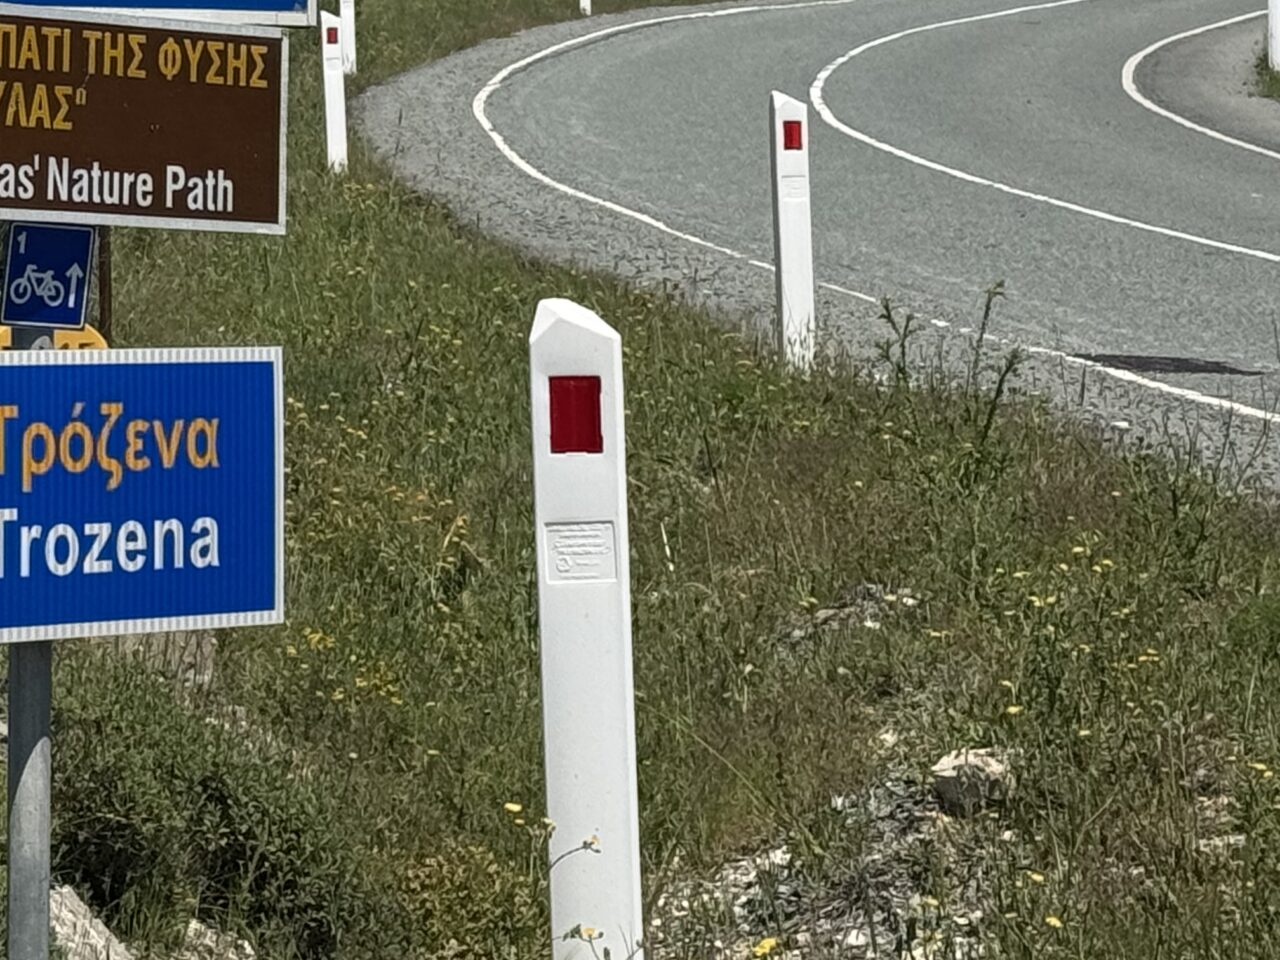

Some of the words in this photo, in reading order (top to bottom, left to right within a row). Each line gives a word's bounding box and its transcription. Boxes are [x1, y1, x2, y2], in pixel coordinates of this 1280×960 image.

[83, 30, 147, 79] ΤΗΣ
[158, 38, 269, 89] ΦΥΣΗΣ
[46, 158, 154, 207] Nature
[165, 171, 234, 212] Path
[17, 231, 27, 254] 1
